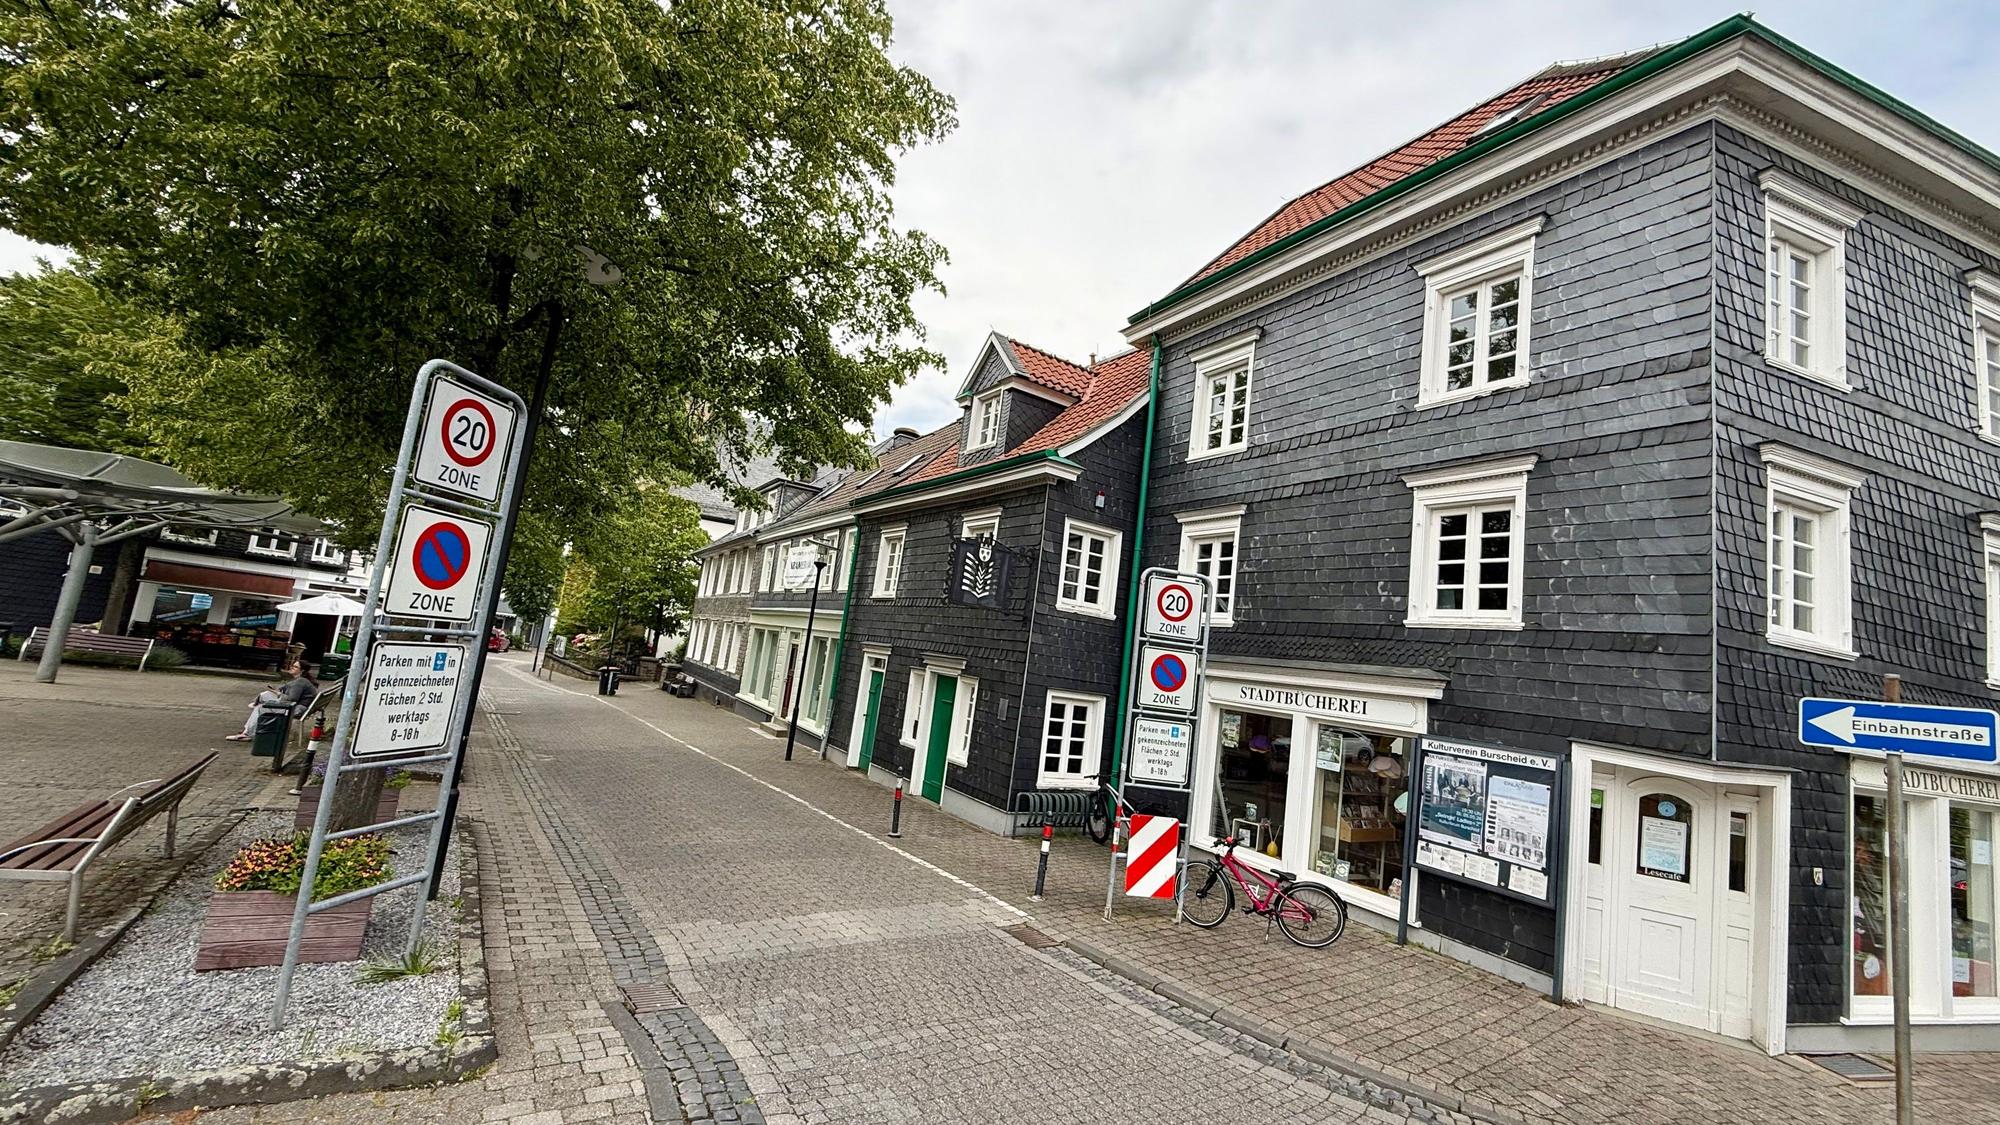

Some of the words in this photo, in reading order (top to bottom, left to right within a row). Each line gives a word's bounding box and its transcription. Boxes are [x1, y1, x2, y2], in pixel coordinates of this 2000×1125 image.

[453, 416, 486, 451] 20
[438, 464, 480, 491] ZONE
[409, 592, 455, 612] ZONE
[1165, 594, 1186, 612] 20
[1159, 622, 1187, 635] ZONE
[379, 654, 413, 668] Parken
[416, 655, 432, 668] mit
[447, 656, 456, 668] in
[374, 674, 455, 691] gekennzeichneten
[378, 691, 416, 706] Flächen
[419, 691, 426, 705] 2
[427, 691, 443, 704] Std.
[1152, 693, 1181, 706] ZONE
[1239, 685, 1369, 715] STADTBÜCHEREI
[388, 710, 430, 725] werktags
[1139, 724, 1158, 734] Parken
[1160, 728, 1169, 736] mit
[1852, 719, 1984, 742] Einbahnstraße
[1137, 736, 1187, 749] gekennzeichneten
[1140, 745, 1163, 756] Flächen
[1164, 749, 1169, 757] 2
[1427, 741, 1478, 757] Kulturverein
[1480, 749, 1527, 764] Burscheid
[1529, 758, 1539, 766] e.
[1541, 758, 1551, 768] V.
[1147, 758, 1173, 768] werktags
